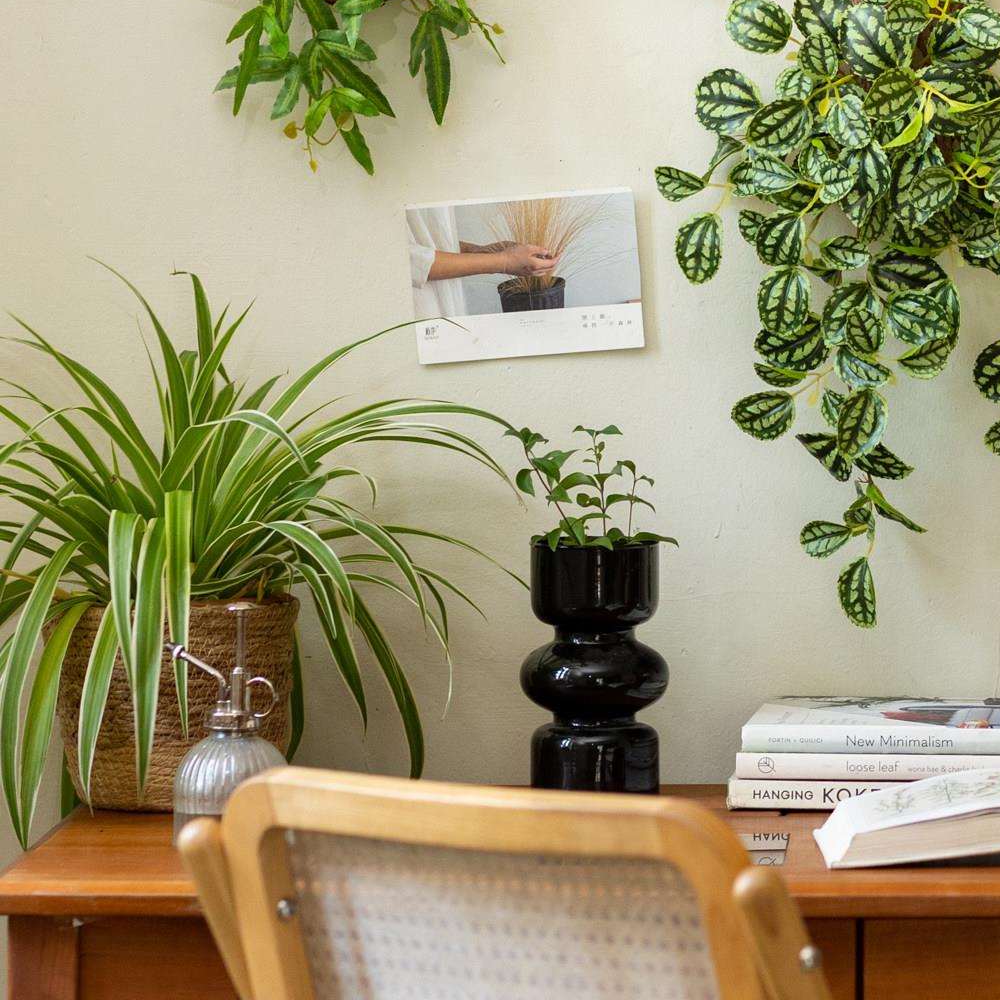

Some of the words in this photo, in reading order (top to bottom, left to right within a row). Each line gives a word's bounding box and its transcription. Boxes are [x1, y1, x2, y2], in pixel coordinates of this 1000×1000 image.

[846, 735, 875, 747] New
[880, 735, 953, 748] Minimalism
[846, 760, 875, 773] loose
[878, 760, 900, 773] leaf
[753, 789, 814, 800] HANGING
[823, 788, 881, 804] KOK
